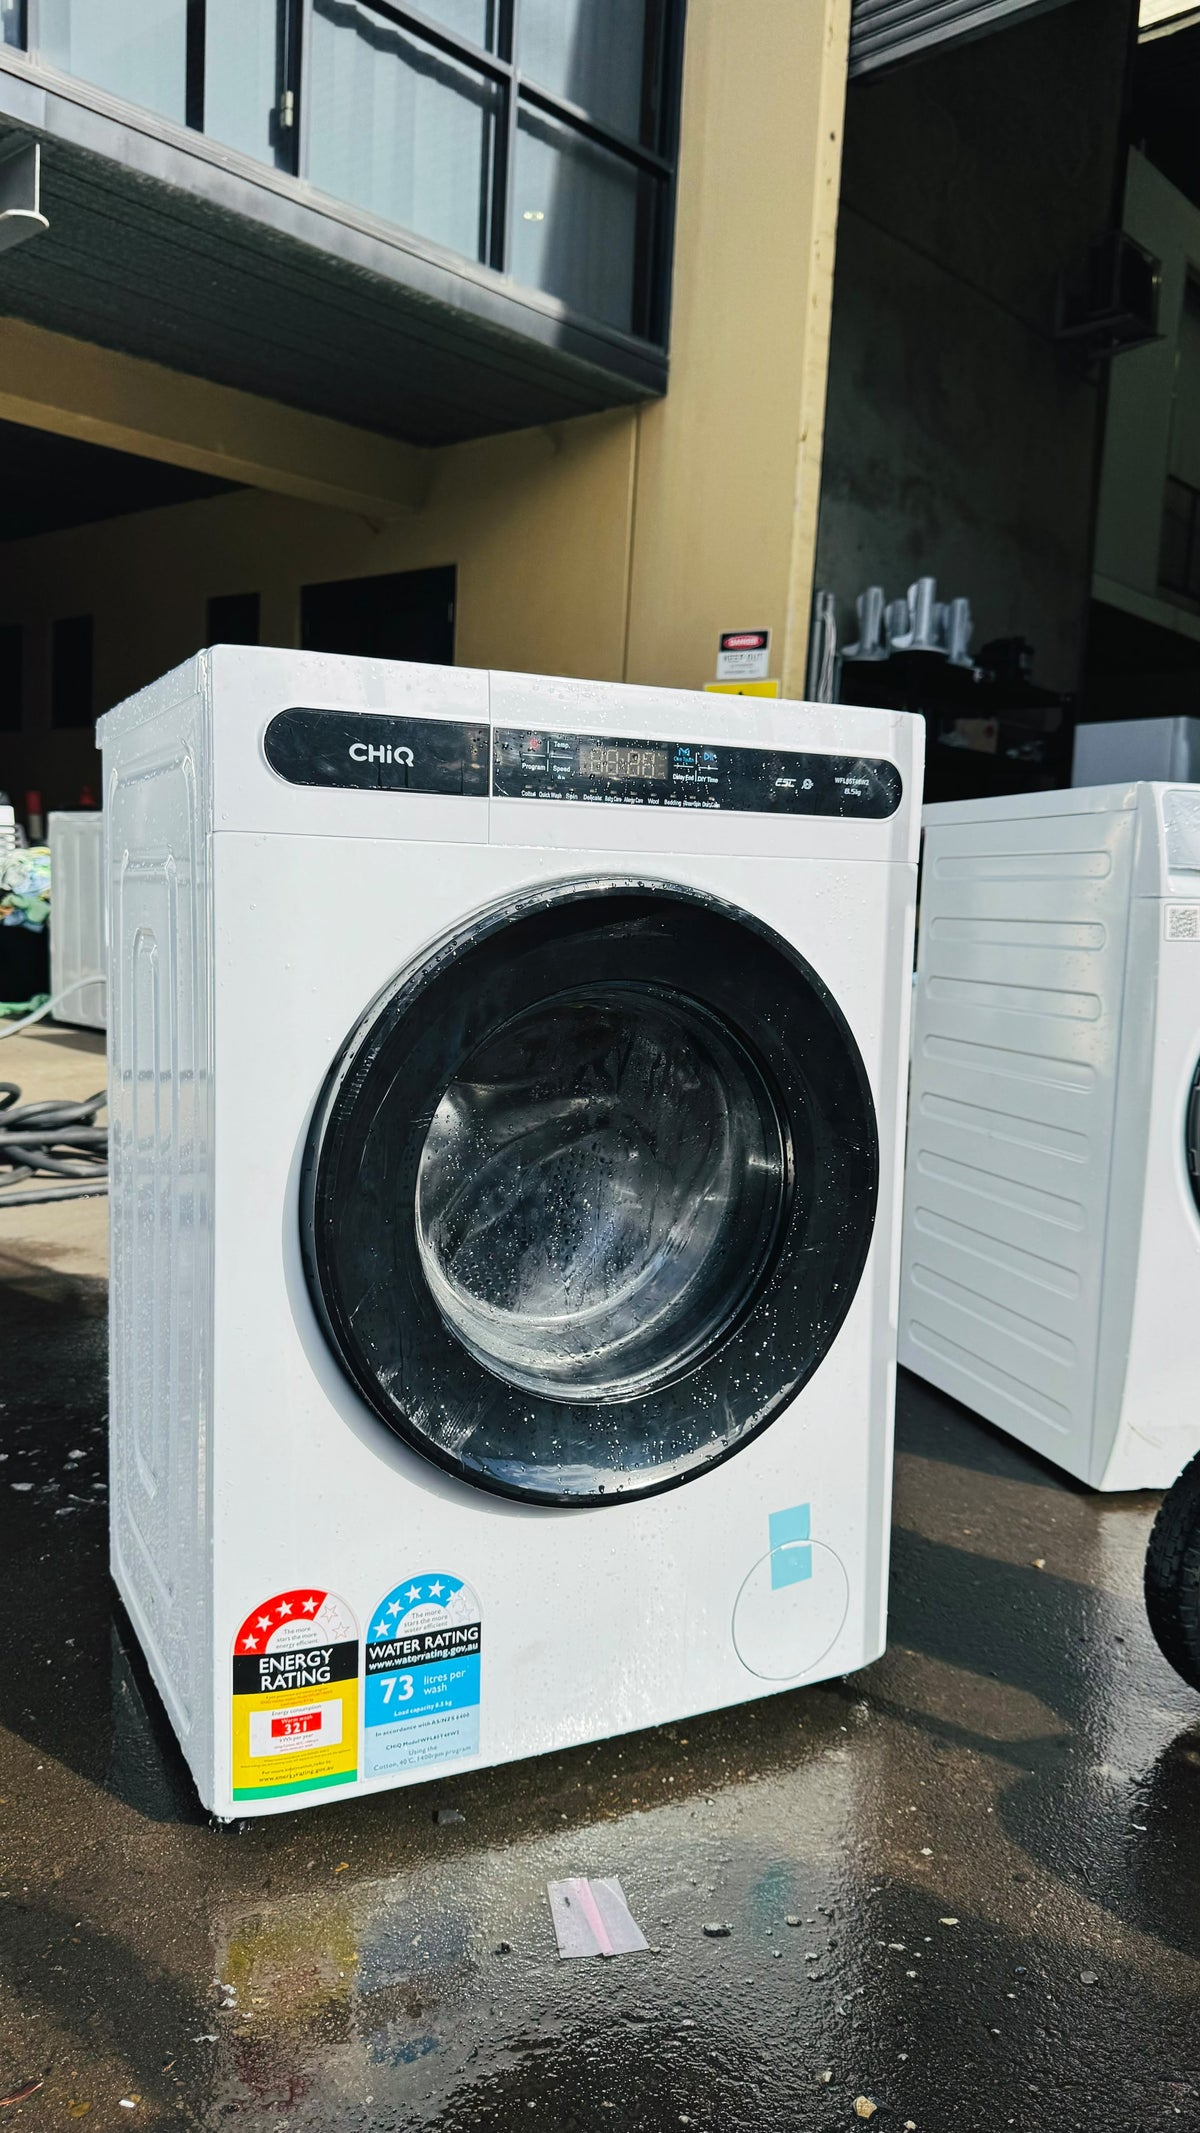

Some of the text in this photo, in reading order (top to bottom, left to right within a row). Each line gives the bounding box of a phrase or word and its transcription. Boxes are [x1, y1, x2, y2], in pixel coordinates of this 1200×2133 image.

[349, 742, 414, 767] CHiQ
[521, 762, 571, 773] Program Speed
[672, 773, 685, 781] Delay
[664, 799, 682, 807] Bedding
[424, 1609, 441, 1617] more
[404, 1614, 448, 1628] stars the more
[423, 1621, 448, 1630] efficient
[276, 1639, 319, 1650] energy efficient
[369, 1627, 479, 1660] WATER RATING
[259, 1648, 334, 1674] ENERGY
[368, 1642, 479, 1671] www.waterrating.gov.au
[261, 1666, 331, 1691] RATING
[423, 1669, 466, 1686] litres per
[380, 1674, 414, 1704] 73
[423, 1683, 448, 1695] wash
[271, 1704, 322, 1717] Energy consumption
[394, 1709, 410, 1717] Load
[410, 1704, 435, 1715] capacity
[281, 1716, 299, 1724] Warm
[284, 1720, 308, 1735] 321
[382, 1725, 417, 1736] accordance
[385, 1742, 402, 1750] CHiQ
[402, 1739, 420, 1747] Model
[408, 1744, 438, 1756] Using the
[445, 1745, 472, 1756] program
